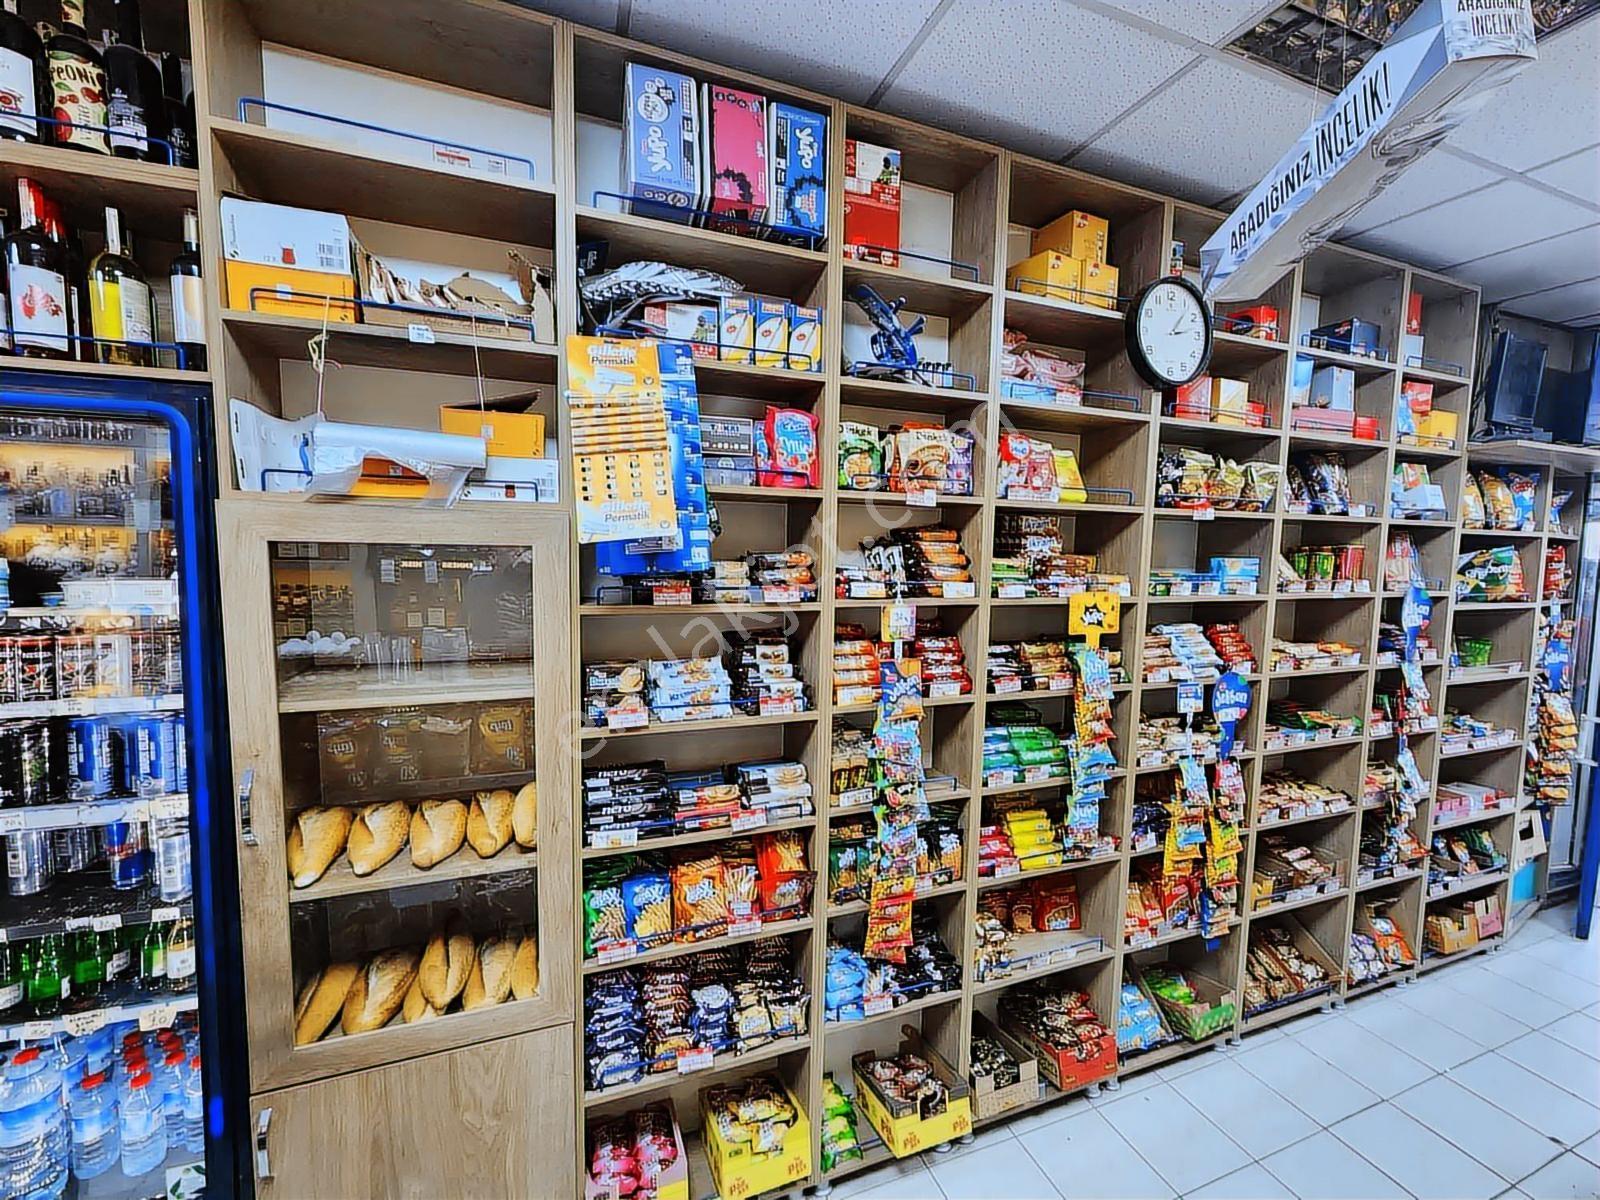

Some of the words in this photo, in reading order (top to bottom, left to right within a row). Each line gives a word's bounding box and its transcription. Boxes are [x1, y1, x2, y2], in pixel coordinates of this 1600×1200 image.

[1229, 149, 1312, 255] ARADIĞINIZ
[1313, 62, 1392, 176] İNCELİK!
[1167, 291, 1176, 301] 12
[1190, 313, 1198, 323] 2
[1193, 331, 1201, 341] 3
[591, 355, 635, 366] Permatik
[1166, 367, 1174, 377] 6
[604, 511, 651, 523] Permatik
